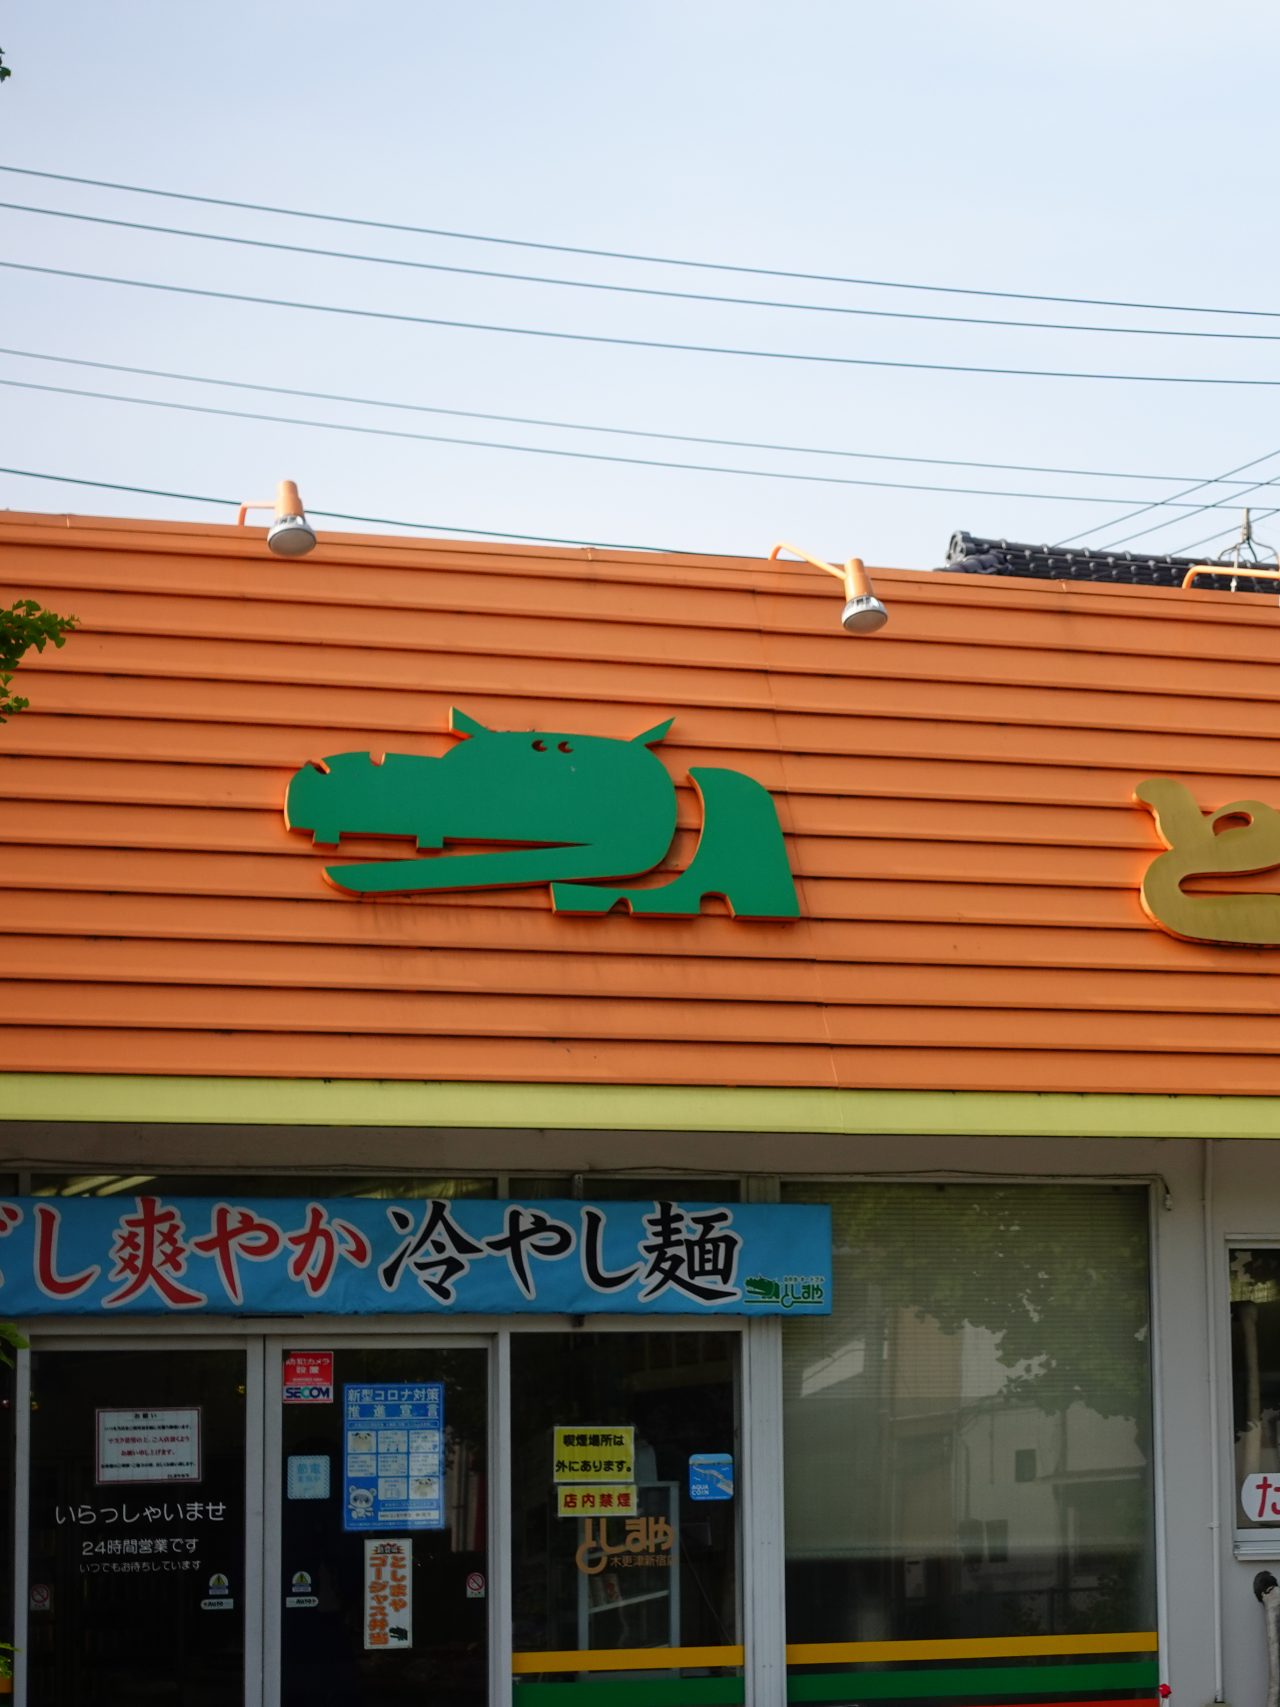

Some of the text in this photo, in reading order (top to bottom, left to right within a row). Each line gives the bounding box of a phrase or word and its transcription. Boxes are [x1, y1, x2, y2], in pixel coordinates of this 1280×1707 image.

[286, 1387, 329, 1399] SECOM
[347, 1388, 440, 1402] 新型コロナ対策
[563, 1434, 625, 1447] 喫煙場所は
[555, 1460, 632, 1473] 外にあります。
[563, 1492, 632, 1508] 店内禁煙
[55, 1501, 226, 1525] いらっしゃいませ
[81, 1538, 200, 1556] 24時間営業です
[575, 1517, 674, 1575] としまや
[80, 1560, 202, 1574] いつでもお待ちしています
